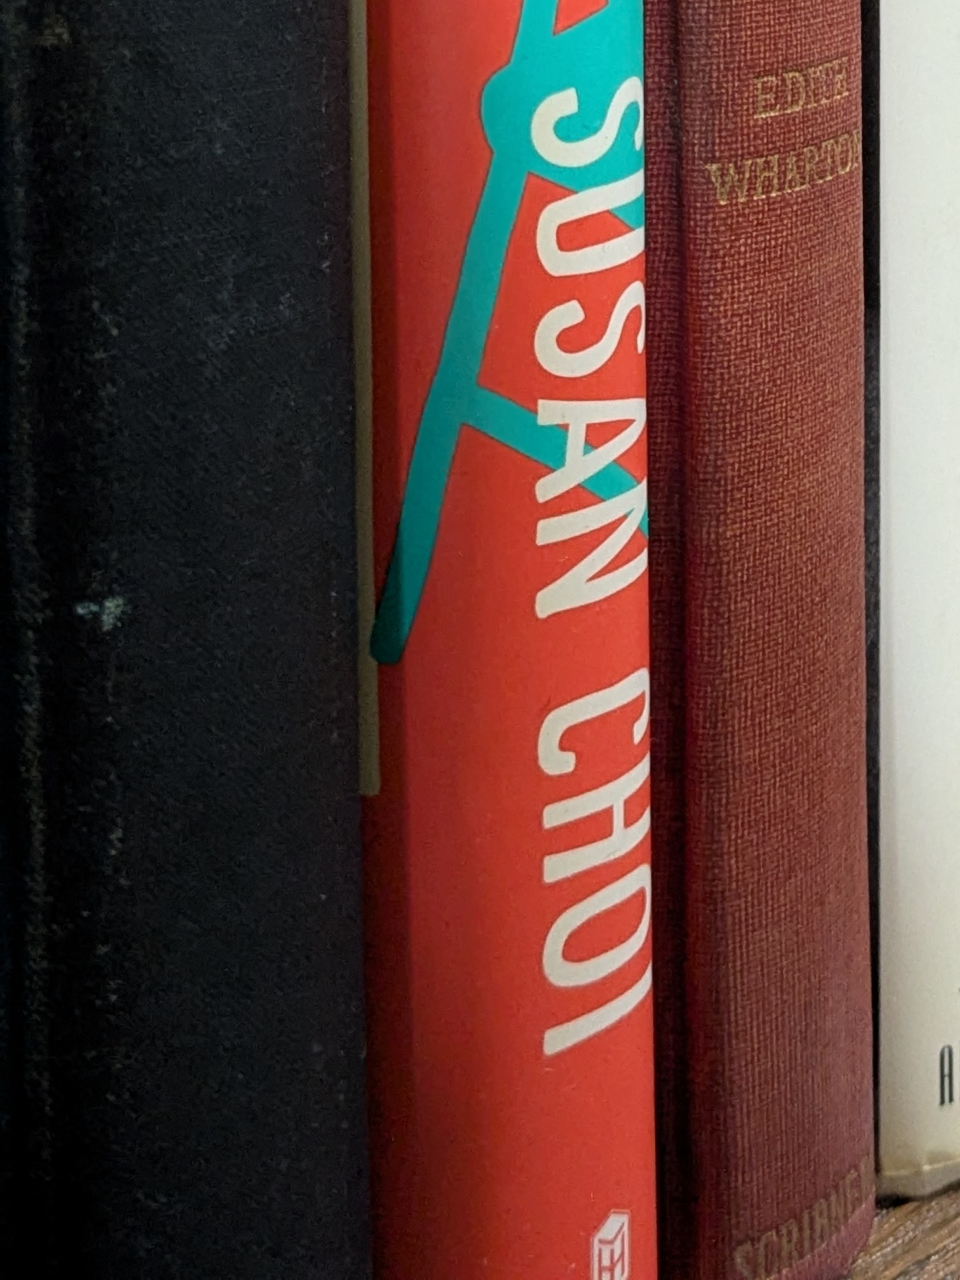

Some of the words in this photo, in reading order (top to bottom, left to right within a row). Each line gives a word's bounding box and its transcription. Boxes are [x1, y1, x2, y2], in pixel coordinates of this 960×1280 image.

[753, 57, 849, 118] EDITH
[530, 76, 649, 619] SUSAN
[537, 667, 653, 1057] CHOI
